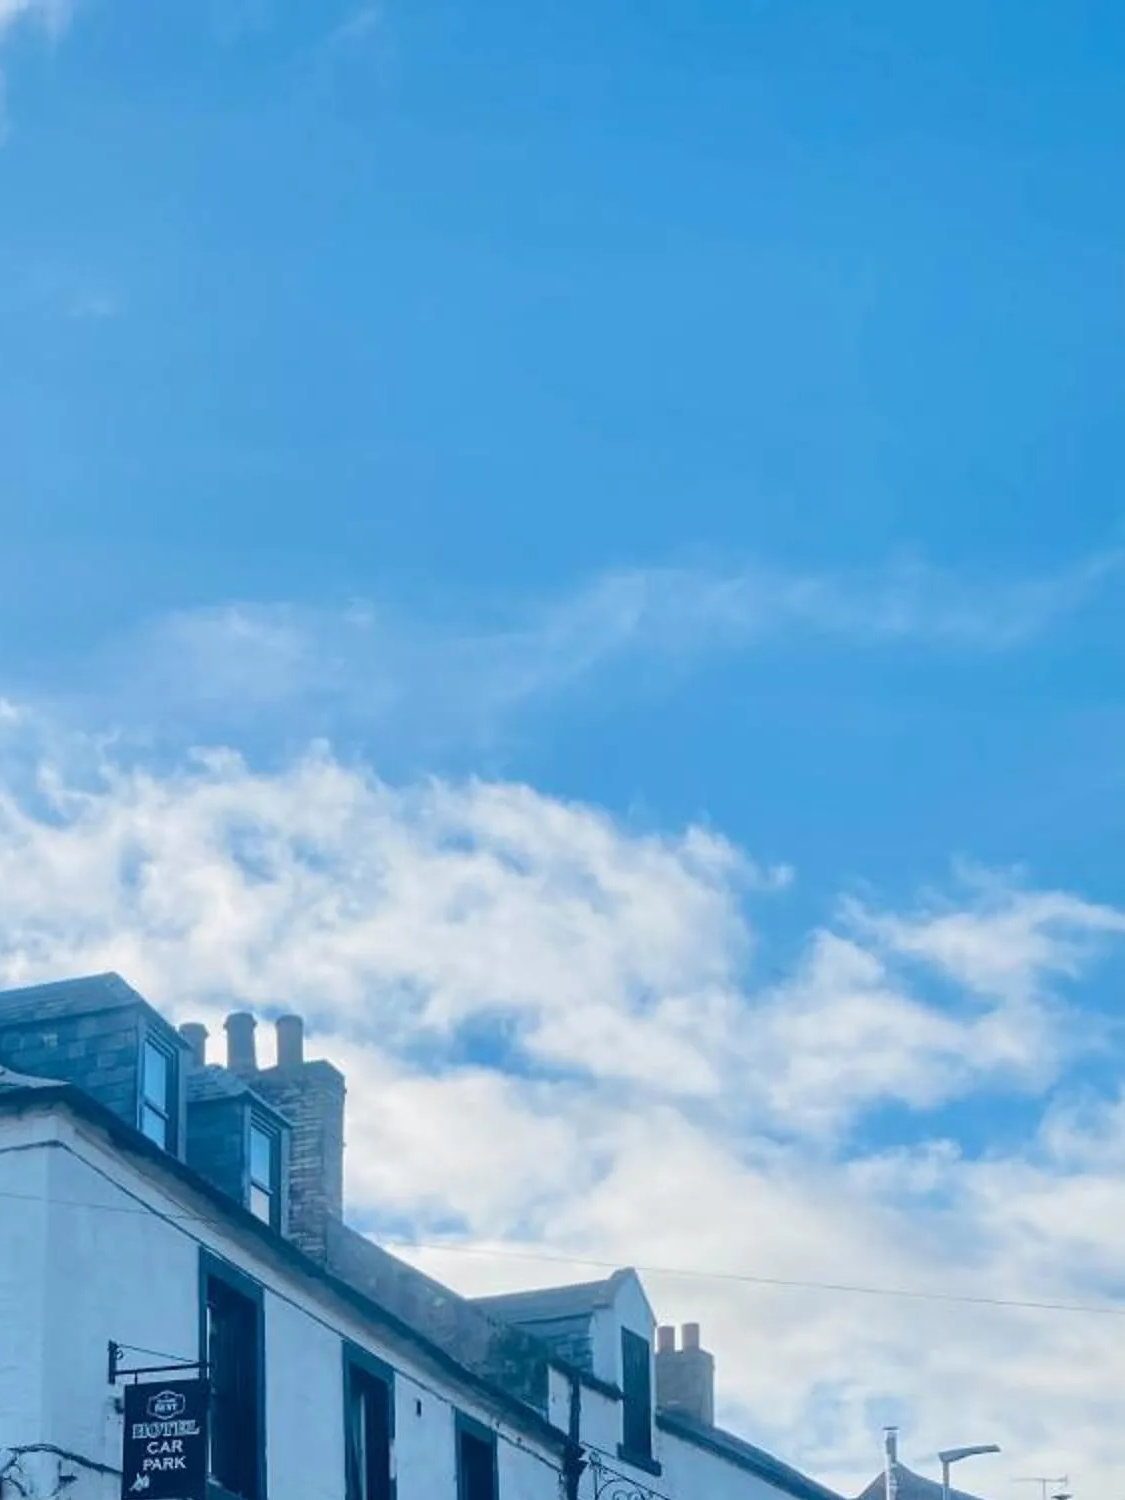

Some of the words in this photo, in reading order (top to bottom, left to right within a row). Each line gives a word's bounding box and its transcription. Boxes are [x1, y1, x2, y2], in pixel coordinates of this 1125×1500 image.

[132, 1419, 200, 1439] HOTEL
[146, 1440, 183, 1454] CAR
[143, 1456, 187, 1471] PARK
